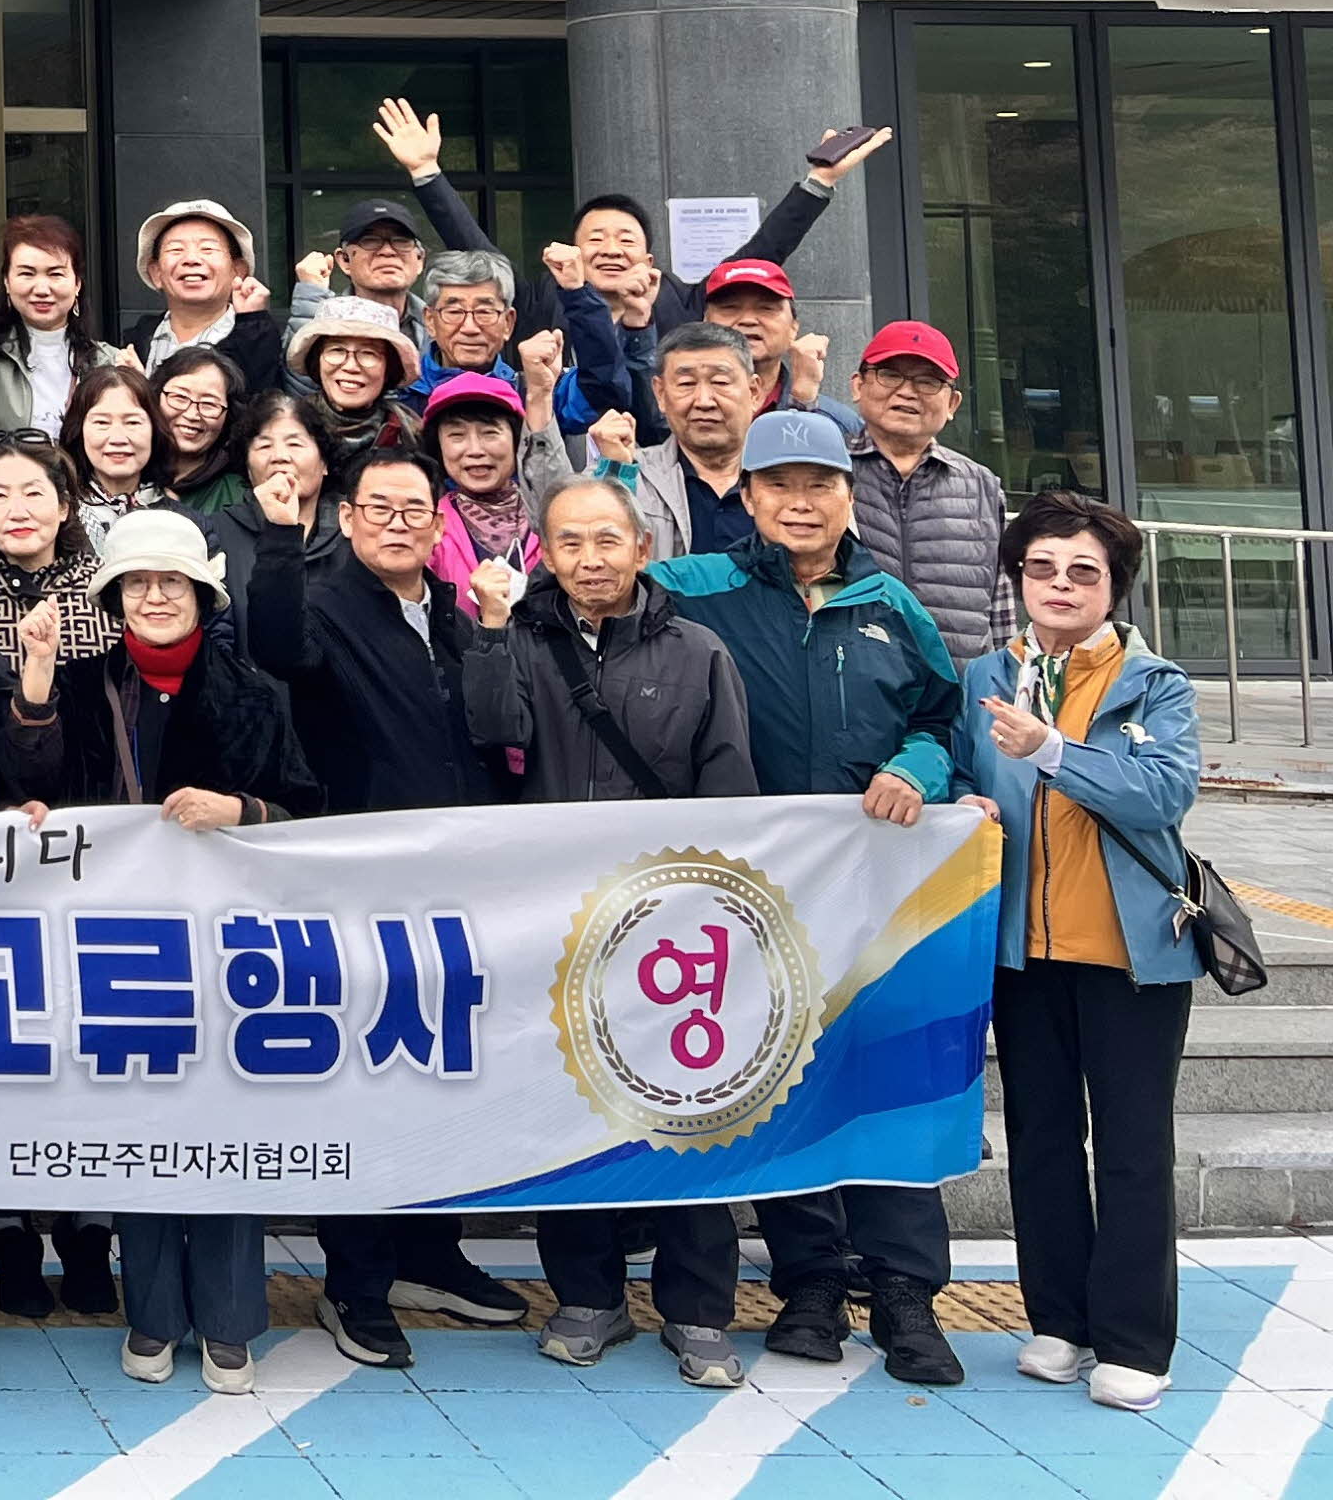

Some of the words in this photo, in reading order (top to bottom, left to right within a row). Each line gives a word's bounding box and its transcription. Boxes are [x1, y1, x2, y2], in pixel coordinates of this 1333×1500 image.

[781, 422, 809, 447] NY
[638, 925, 728, 1069] 영
[10, 1141, 350, 1180] 단양군주민자치협의회
